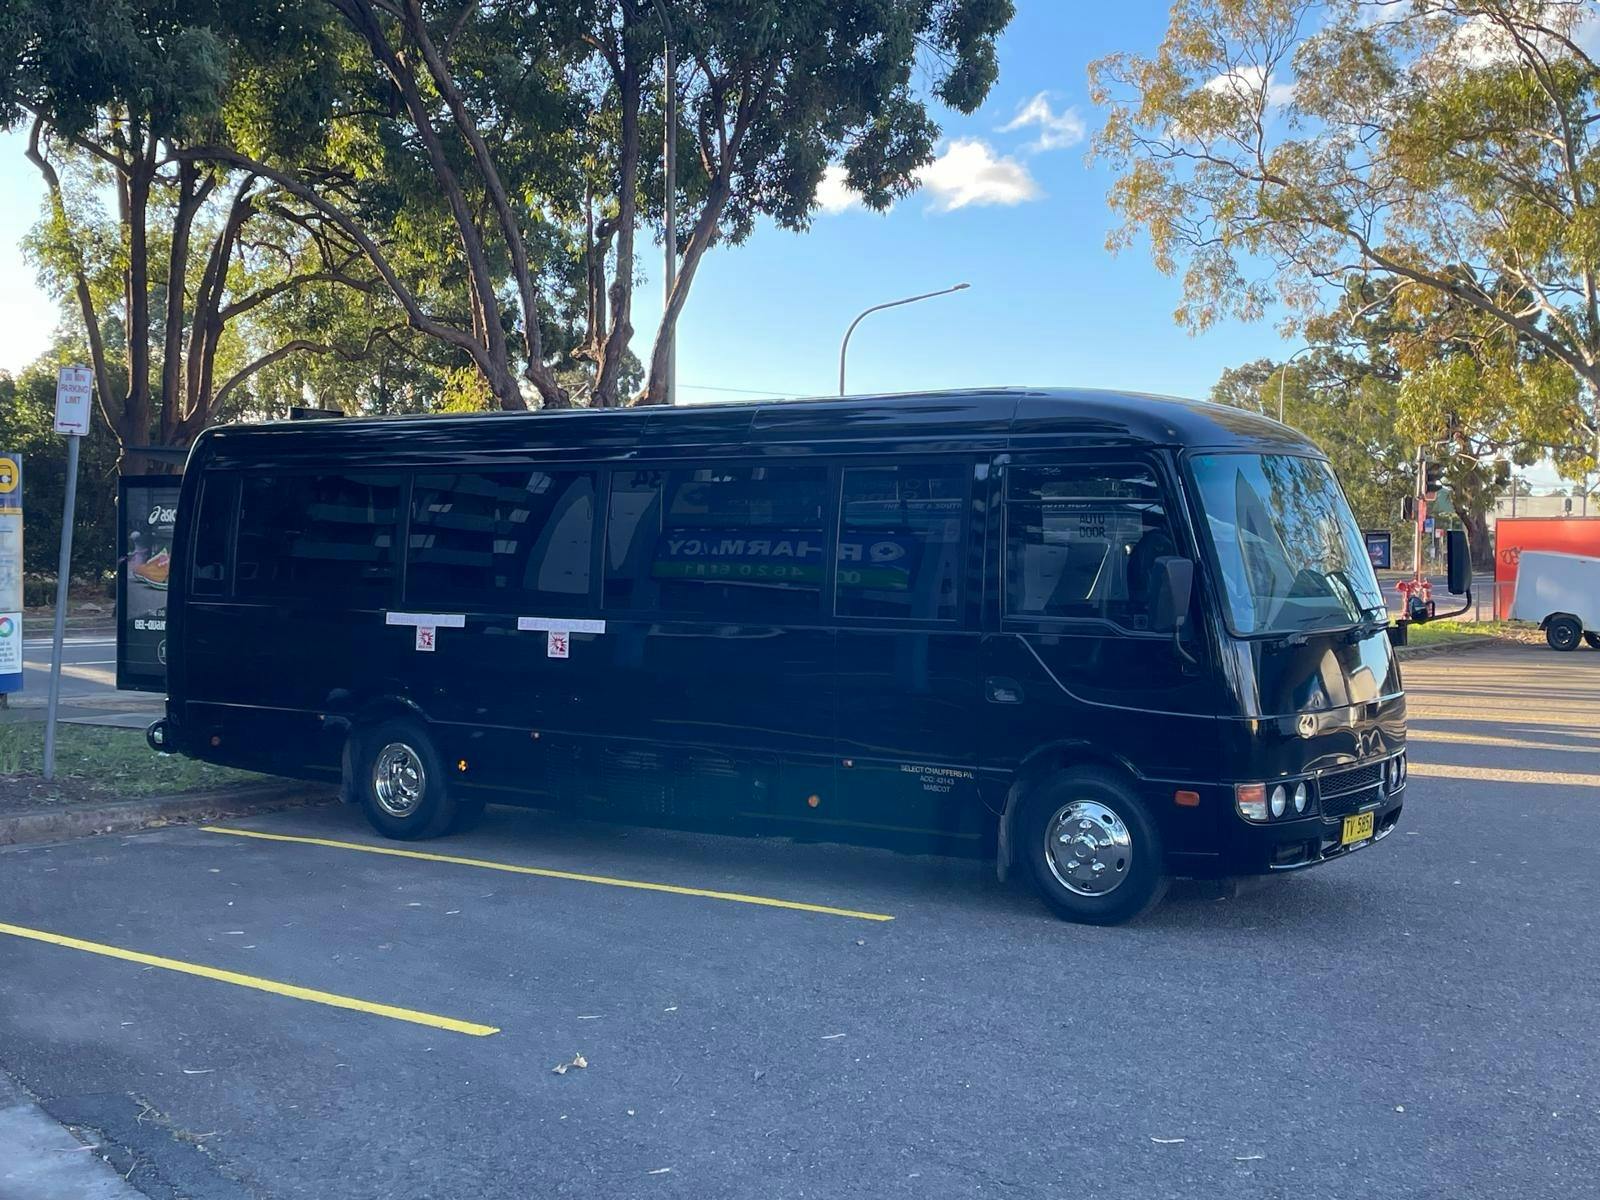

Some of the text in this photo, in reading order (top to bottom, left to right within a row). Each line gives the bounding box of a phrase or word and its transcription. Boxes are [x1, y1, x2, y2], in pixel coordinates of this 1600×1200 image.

[60, 384, 88, 394] PARKING
[1079, 513, 1105, 525] AUTO
[1079, 526, 1106, 539] DOOR
[901, 765, 924, 773] SELECT
[924, 768, 962, 778] CHAUFFERS
[923, 784, 950, 792] MASCOT
